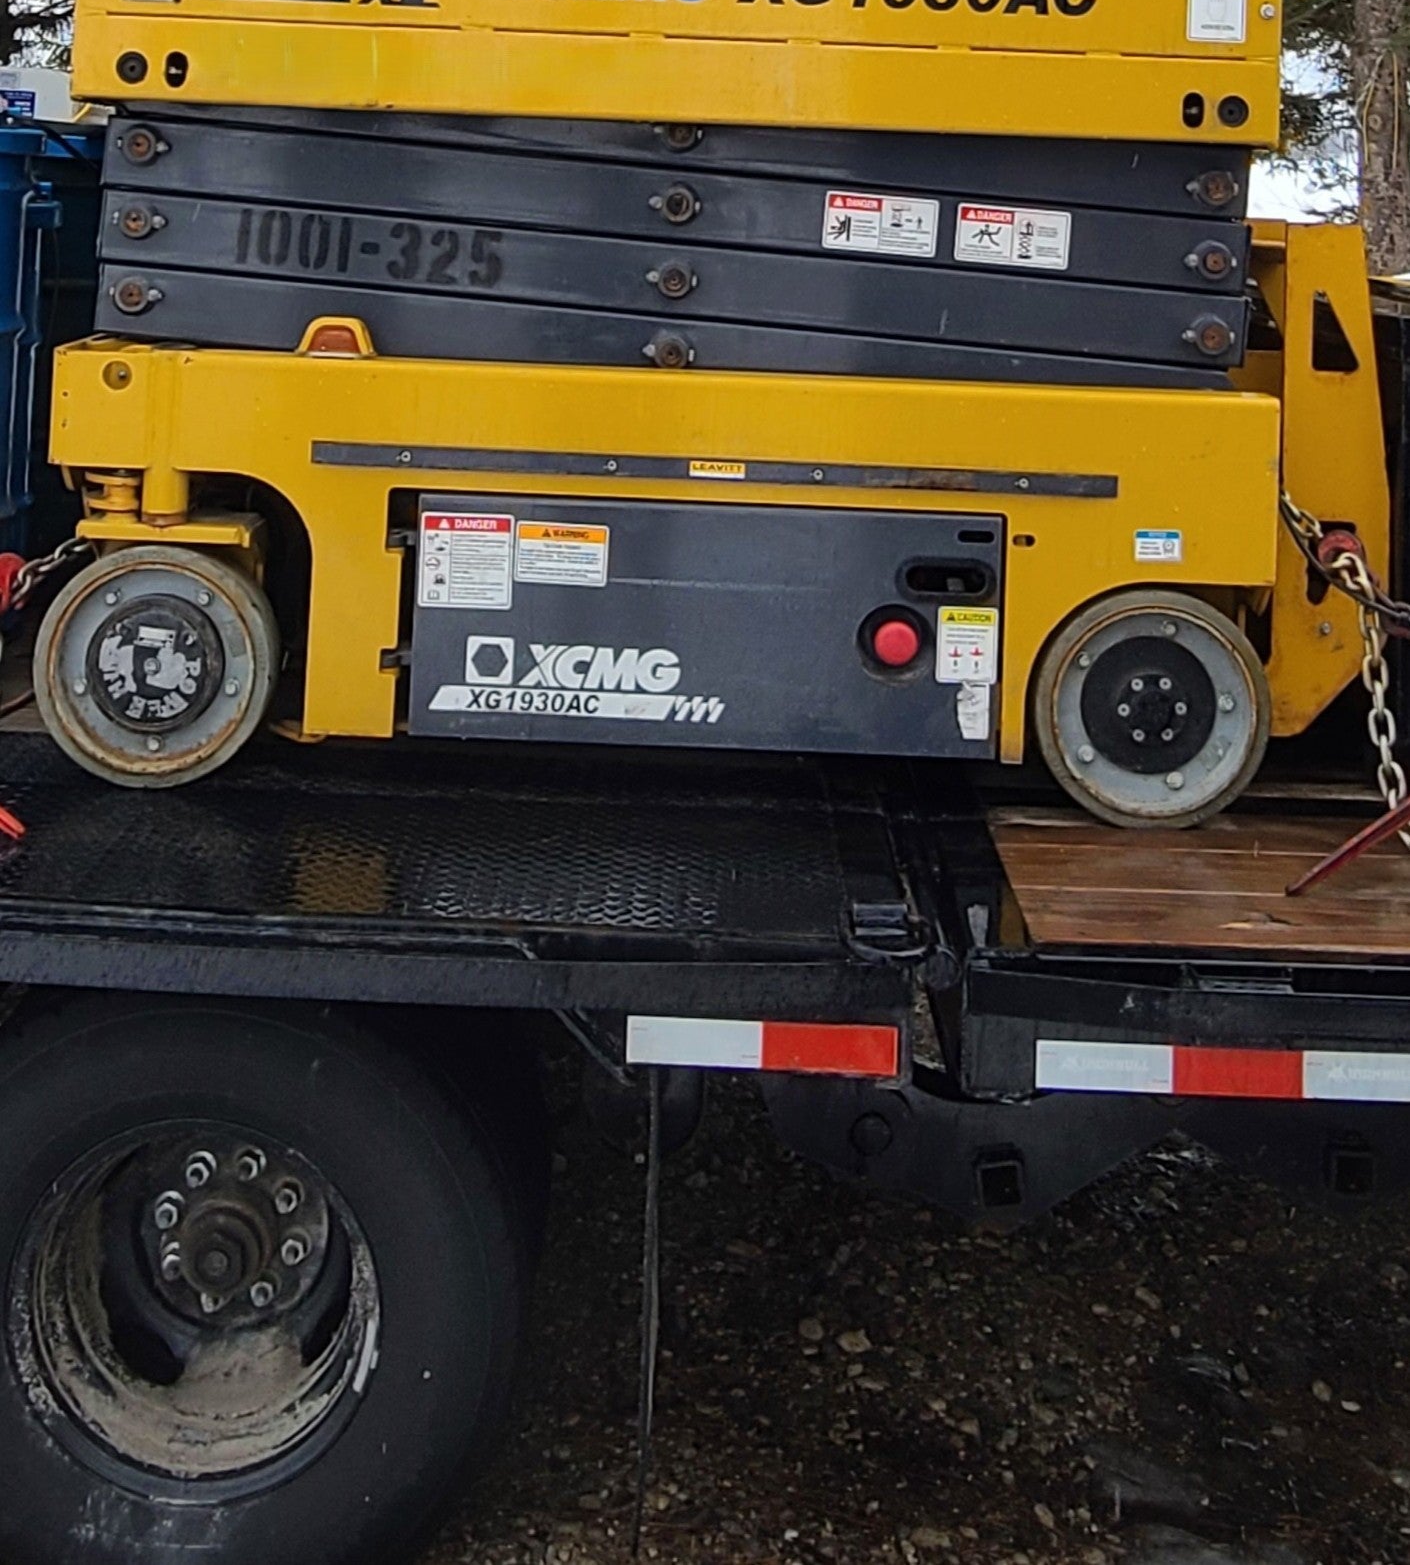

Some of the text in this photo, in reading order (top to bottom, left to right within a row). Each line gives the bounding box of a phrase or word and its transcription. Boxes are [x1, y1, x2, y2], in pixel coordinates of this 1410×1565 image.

[845, 197, 878, 209] DANGER
[976, 210, 1011, 222] DANGER
[235, 208, 504, 288] 1001-325
[692, 463, 743, 473] LEAVITT
[454, 518, 497, 530] DANGER
[519, 644, 681, 692] XCMG
[466, 689, 600, 714] XG1930AC
